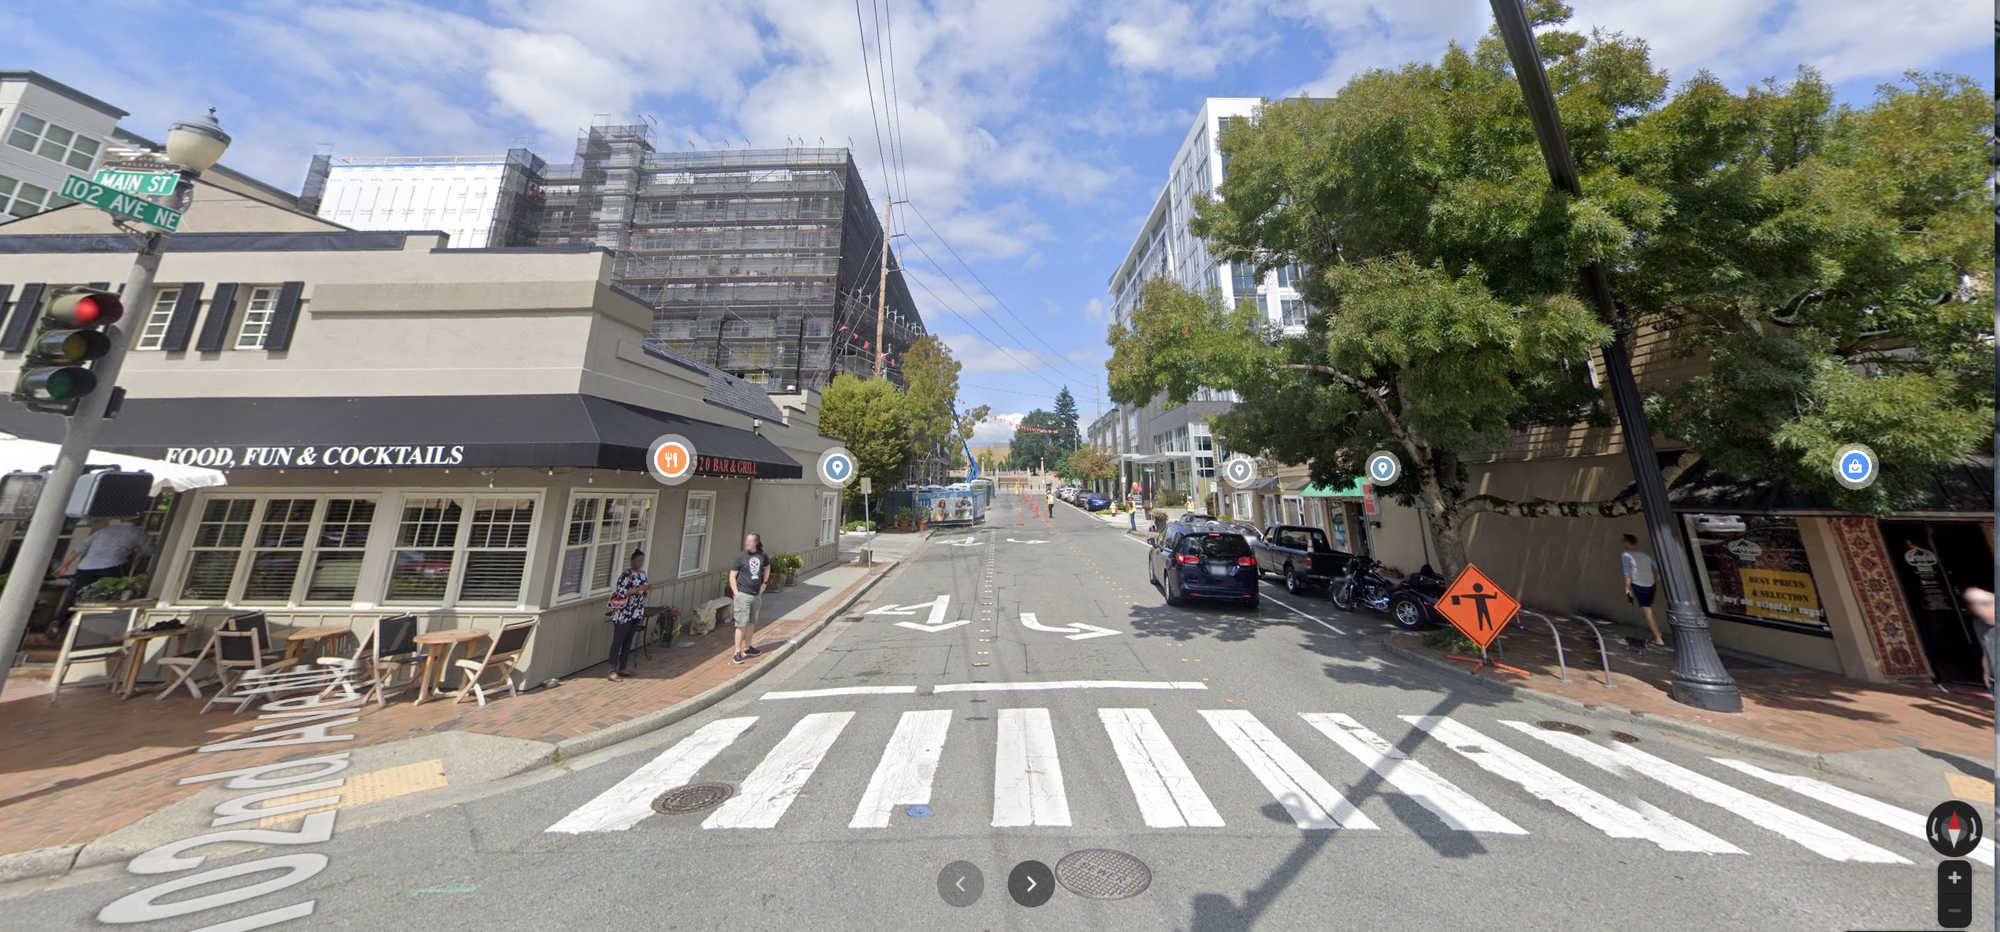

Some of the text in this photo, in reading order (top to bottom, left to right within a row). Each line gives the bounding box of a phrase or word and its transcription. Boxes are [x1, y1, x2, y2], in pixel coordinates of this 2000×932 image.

[100, 173, 172, 193] MAIN ST
[64, 178, 180, 230] 102 AVE NE
[166, 445, 464, 469] FOOD, FUN & COCKTAILS
[712, 458, 729, 472] BAR
[730, 460, 737, 472] &
[737, 461, 758, 474] GRILL
[1748, 576, 1806, 588] BEST PRICES
[1723, 594, 1738, 605] buy
[1760, 590, 1810, 602] SELECTION
[1080, 862, 1126, 884] SEWER
